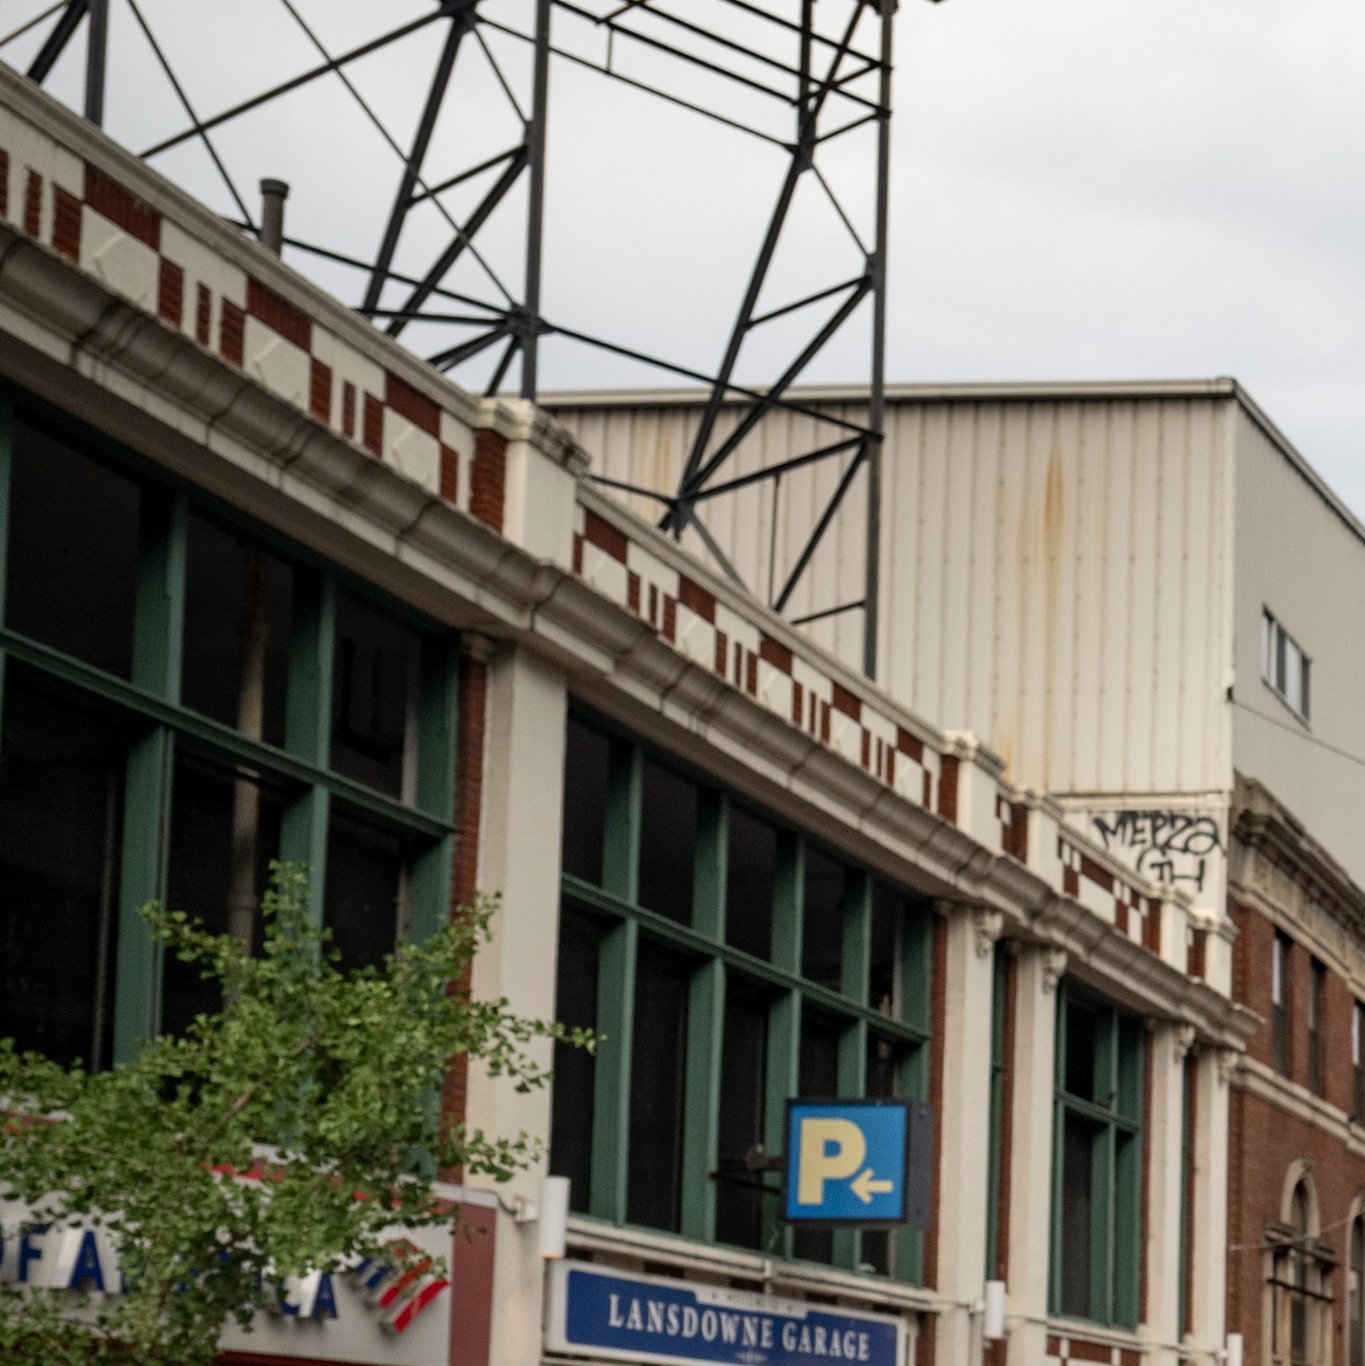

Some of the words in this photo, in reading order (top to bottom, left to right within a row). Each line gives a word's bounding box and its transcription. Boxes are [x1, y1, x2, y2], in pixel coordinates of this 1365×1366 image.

[798, 1117, 866, 1205] P
[608, 1294, 774, 1349] LANSDOWNE
[782, 1321, 871, 1361] GARAGE
